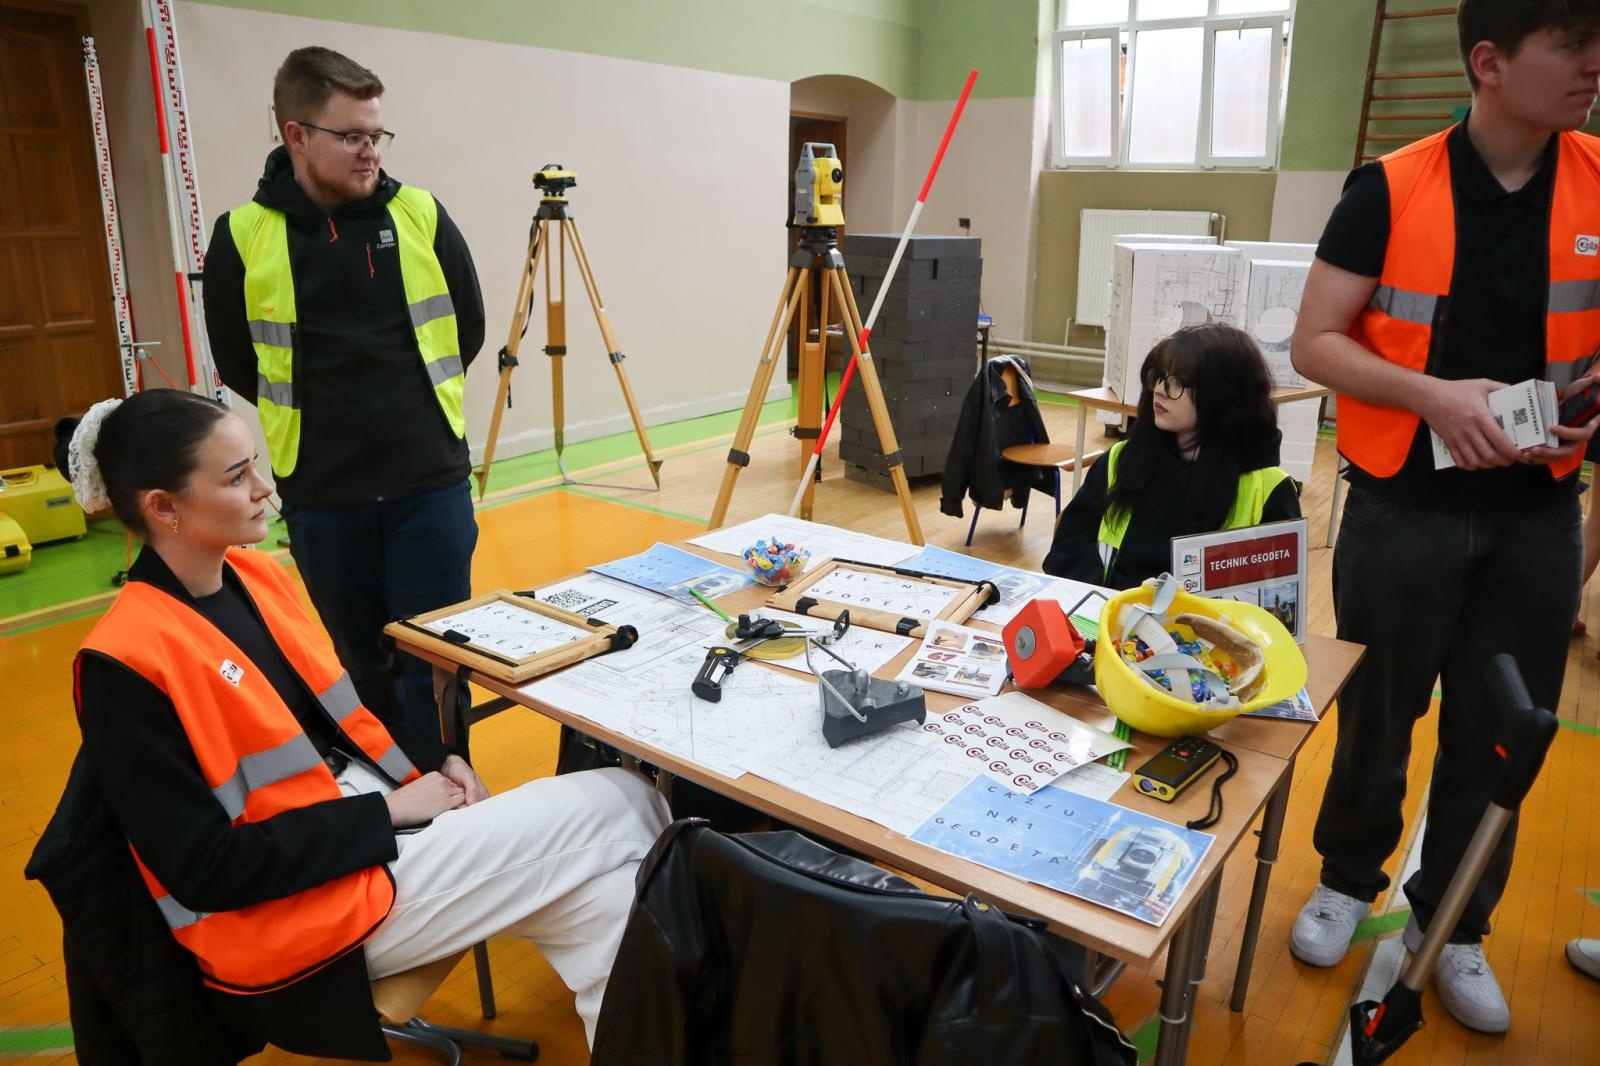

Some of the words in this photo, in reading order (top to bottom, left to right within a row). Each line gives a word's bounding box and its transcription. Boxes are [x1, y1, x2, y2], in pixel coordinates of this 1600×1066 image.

[1209, 555, 1248, 571] TECHNIK
[1251, 549, 1290, 564] GEODETA
[934, 817, 1061, 865] GEODETA
